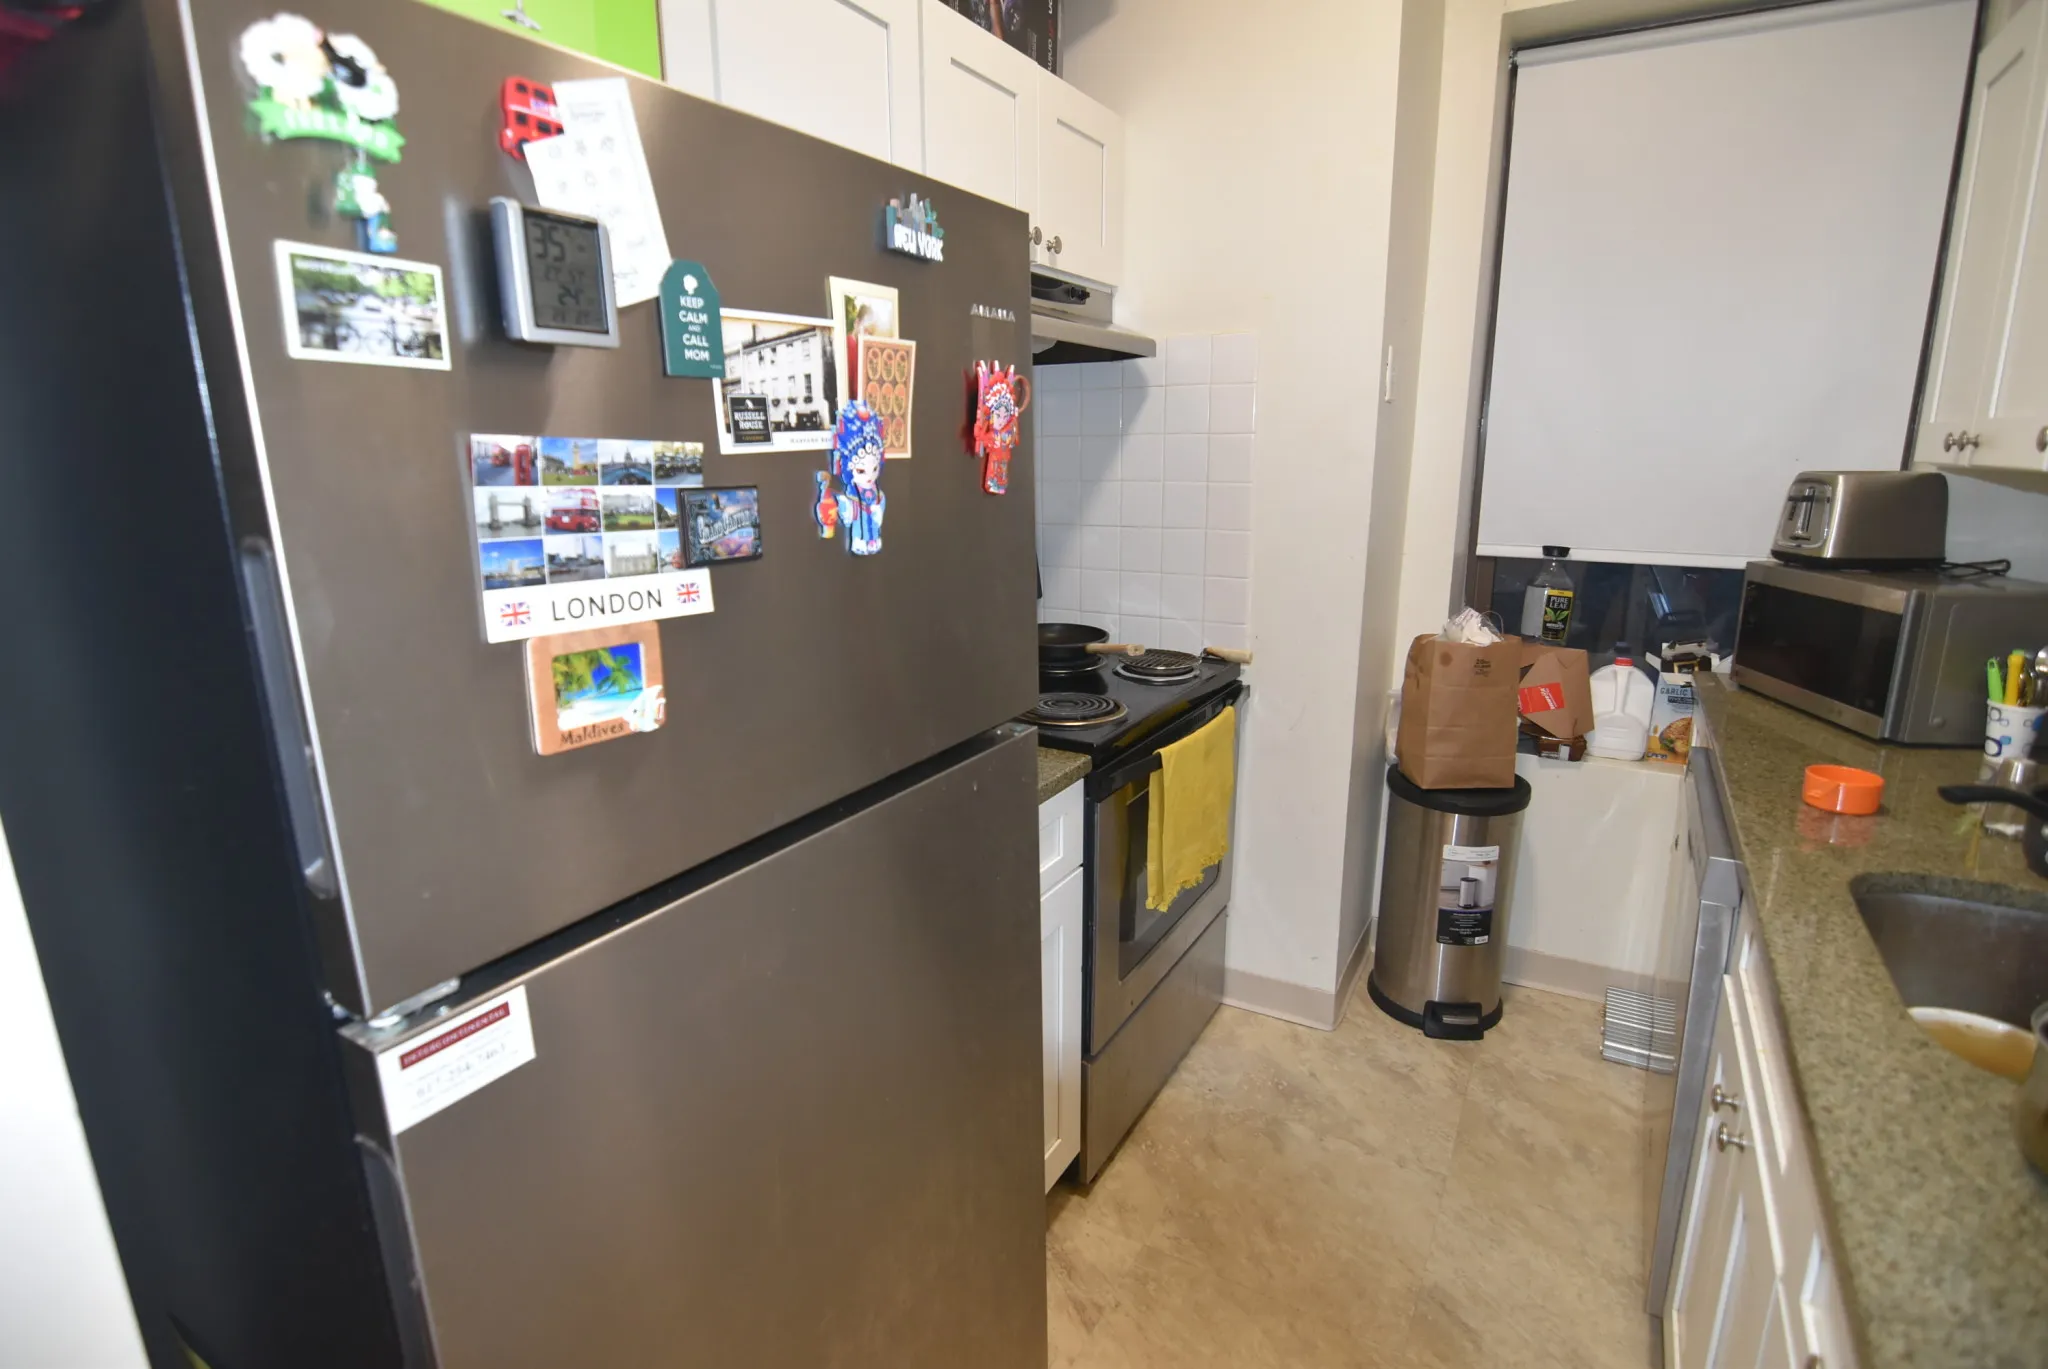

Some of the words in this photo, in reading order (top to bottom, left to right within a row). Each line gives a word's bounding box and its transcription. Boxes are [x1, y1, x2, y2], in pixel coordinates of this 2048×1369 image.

[918, 231, 944, 262] YORK
[679, 295, 705, 309] KEEP
[678, 309, 708, 324] CALM
[682, 333, 709, 348] CALL
[684, 348, 710, 361] MOM
[551, 588, 663, 622] LONDON
[1549, 602, 1568, 610] LEAF
[1550, 596, 1569, 604] PURE
[1660, 687, 1688, 696] GARLIC
[559, 721, 625, 746] Maldives
